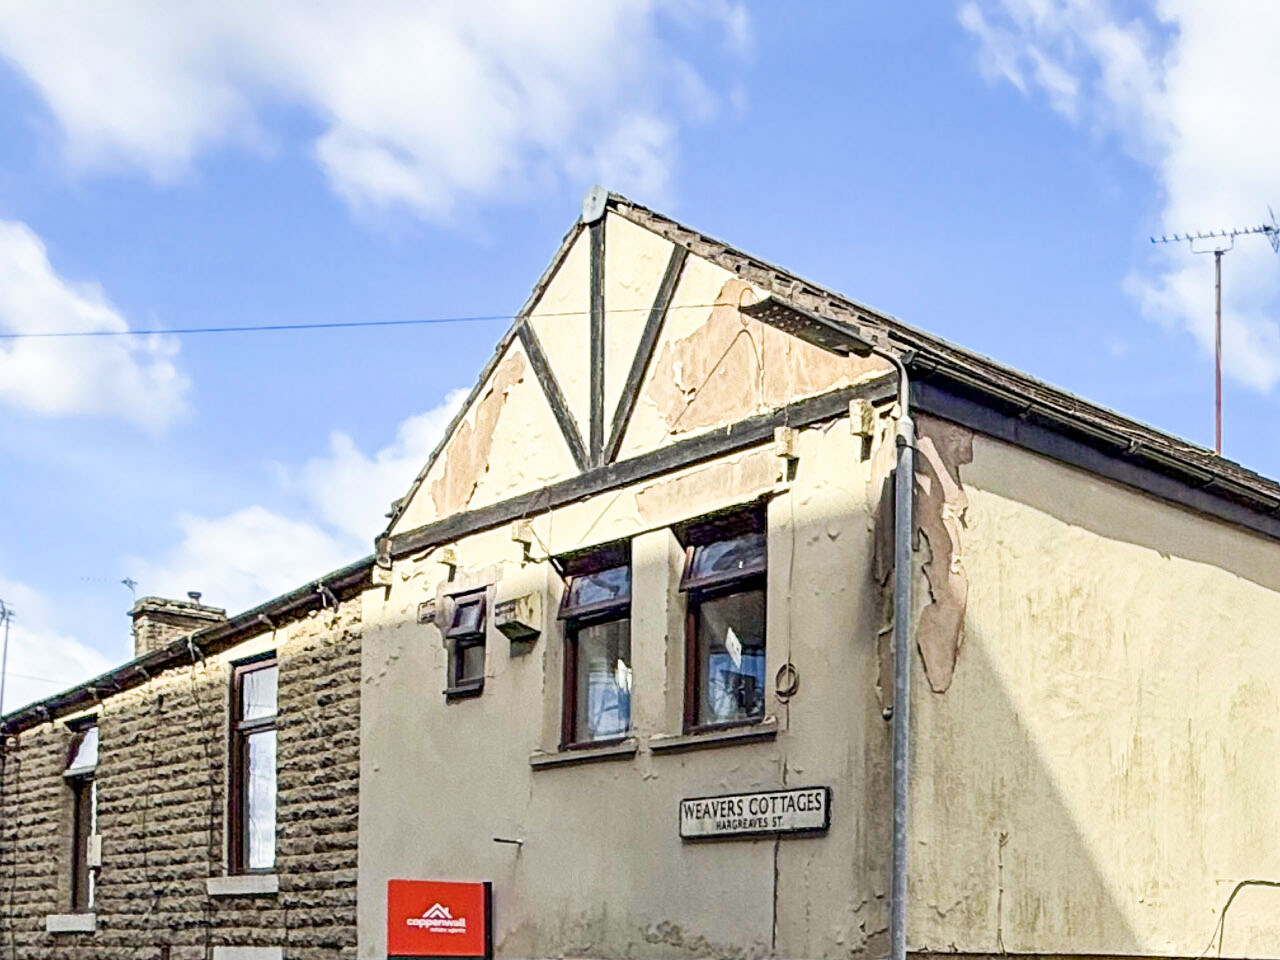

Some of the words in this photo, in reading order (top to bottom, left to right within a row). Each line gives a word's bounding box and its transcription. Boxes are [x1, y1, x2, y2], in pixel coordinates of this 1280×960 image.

[684, 799, 744, 820] WEAVERS
[749, 792, 823, 814] COTTAGES
[716, 817, 769, 830] HARGREAVES
[406, 917, 466, 929] coppenwall
